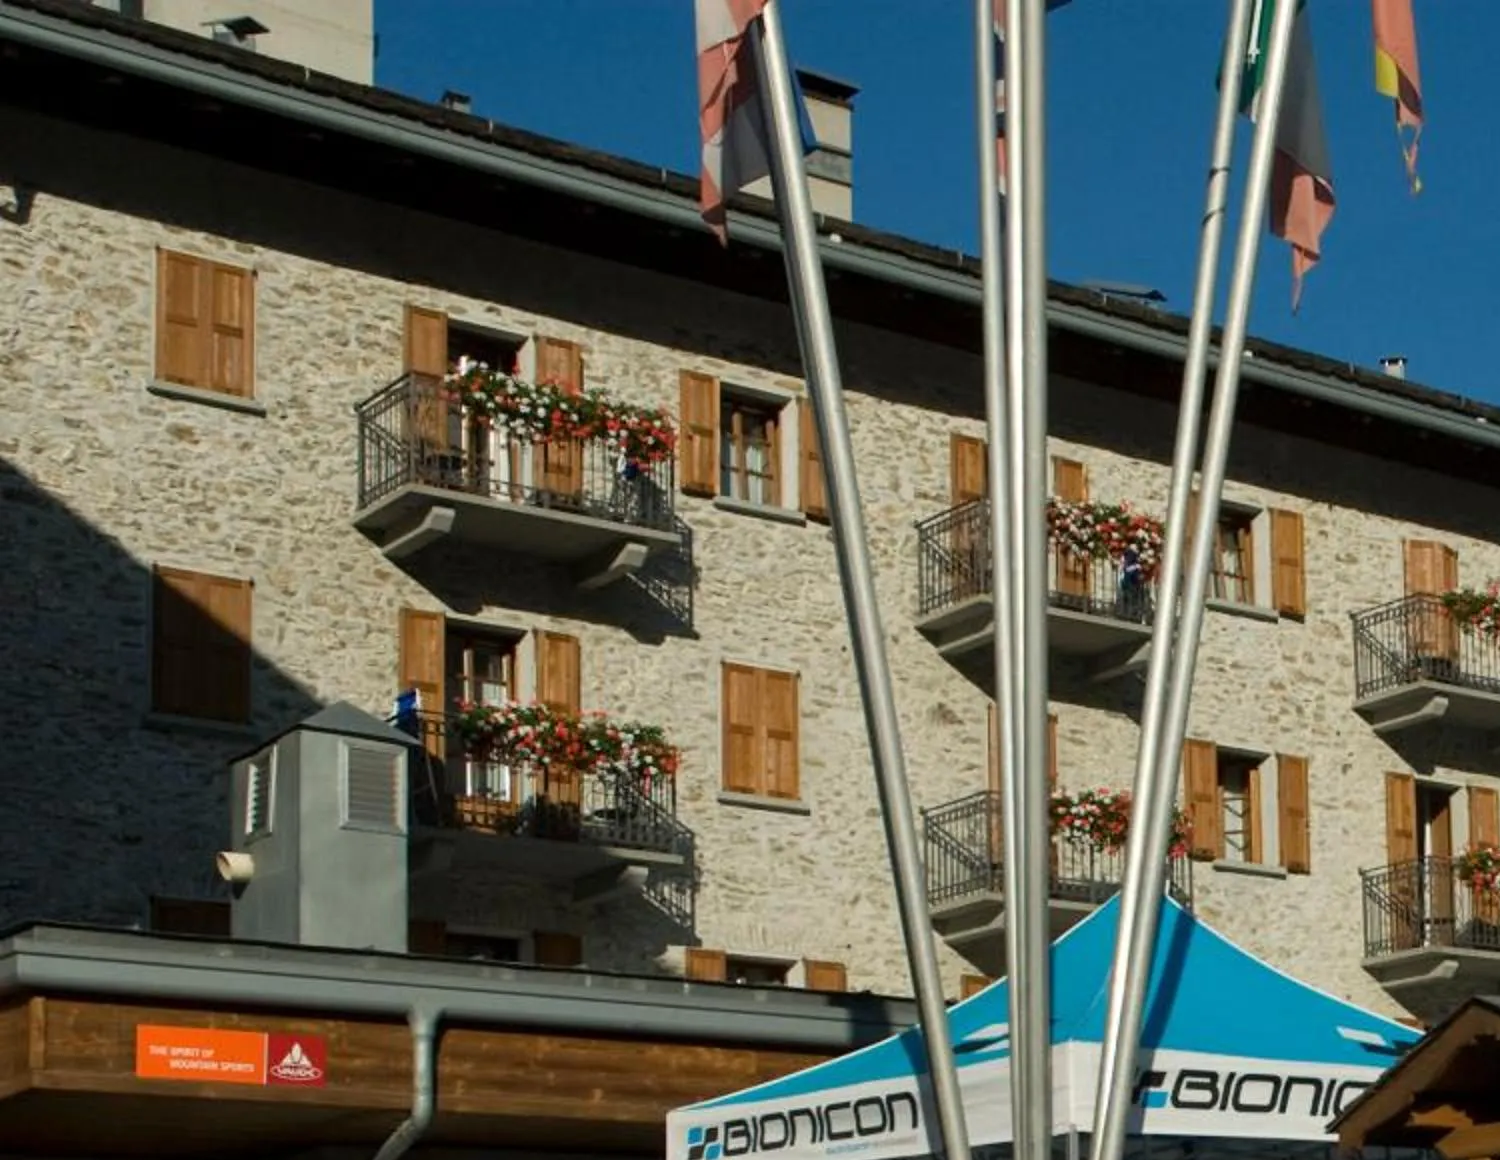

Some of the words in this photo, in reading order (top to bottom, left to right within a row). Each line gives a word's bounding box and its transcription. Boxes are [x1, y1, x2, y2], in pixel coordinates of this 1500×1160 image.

[220, 1061, 255, 1073] SPORTS
[1170, 1068, 1377, 1118] BIONIC
[722, 1091, 919, 1158] BIONICON
